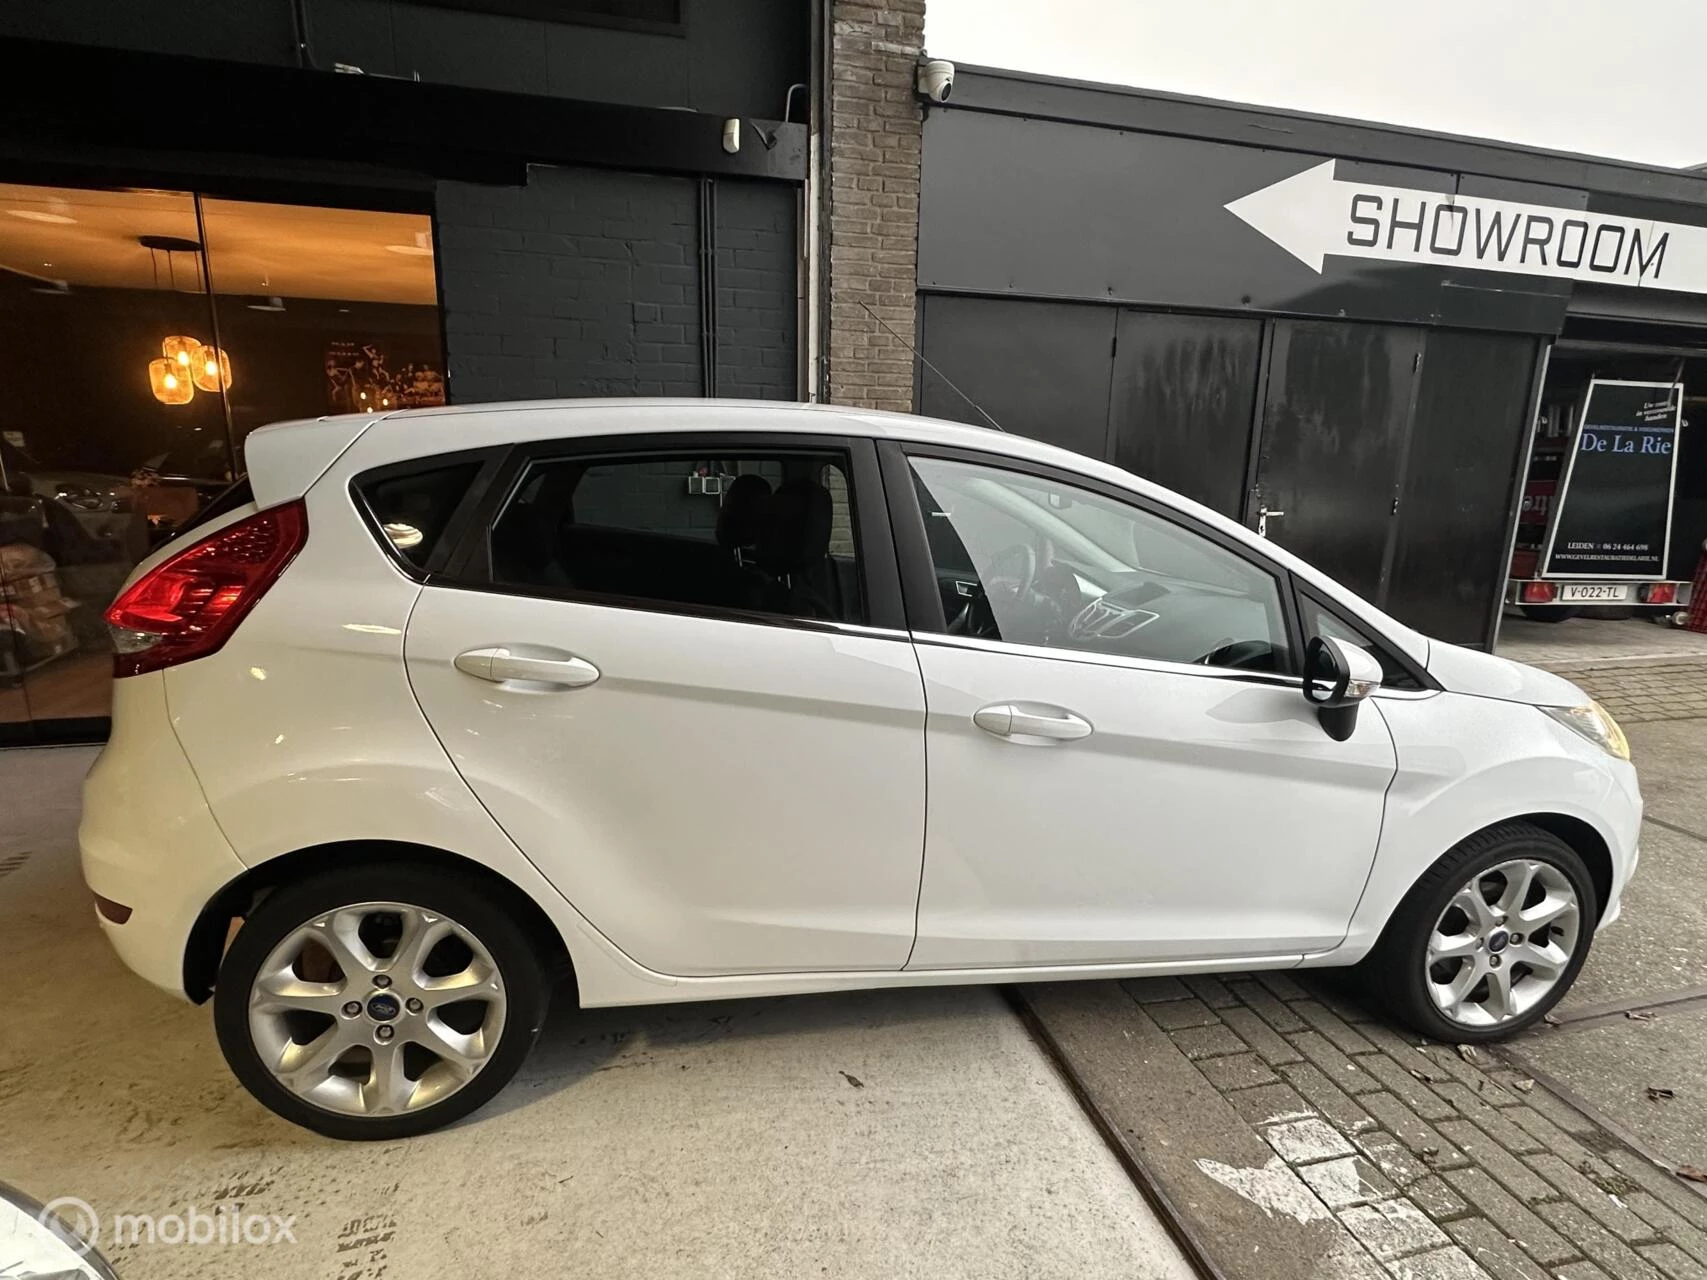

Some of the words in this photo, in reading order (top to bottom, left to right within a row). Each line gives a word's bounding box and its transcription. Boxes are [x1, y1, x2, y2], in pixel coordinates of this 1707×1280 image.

[1347, 194, 1670, 279] SHOWROOM
[1581, 433, 1607, 452] De
[1612, 435, 1634, 453] La
[1640, 436, 1672, 454] Rie
[1570, 586, 1619, 598] V-022-TL
